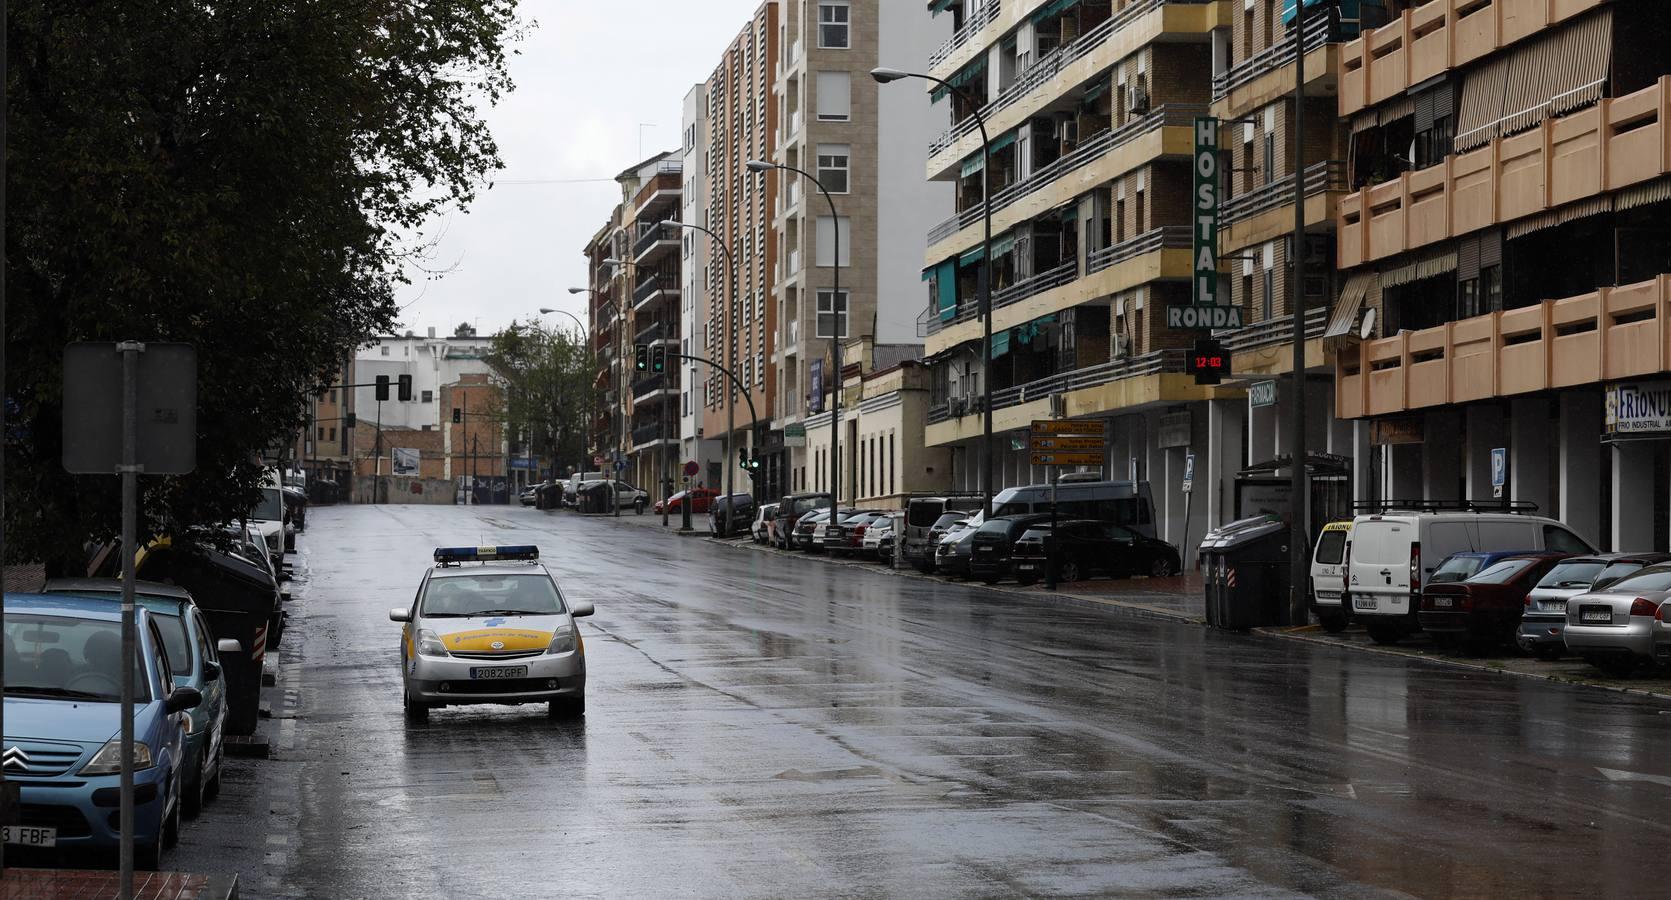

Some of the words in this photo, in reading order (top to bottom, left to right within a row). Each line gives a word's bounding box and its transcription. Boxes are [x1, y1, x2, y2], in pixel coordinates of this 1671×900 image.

[1197, 120, 1215, 302] HOSTAL
[1169, 307, 1241, 328] RONDA
[1195, 356, 1222, 368] 12:03
[1251, 383, 1274, 405] FARMACIA
[1618, 421, 1631, 430] FRIO
[1632, 419, 1661, 429] INDUSTRIAL
[1494, 453, 1503, 481] P
[478, 669, 503, 679] 2082
[504, 667, 523, 678] GPF
[20, 828, 50, 844] FBF
